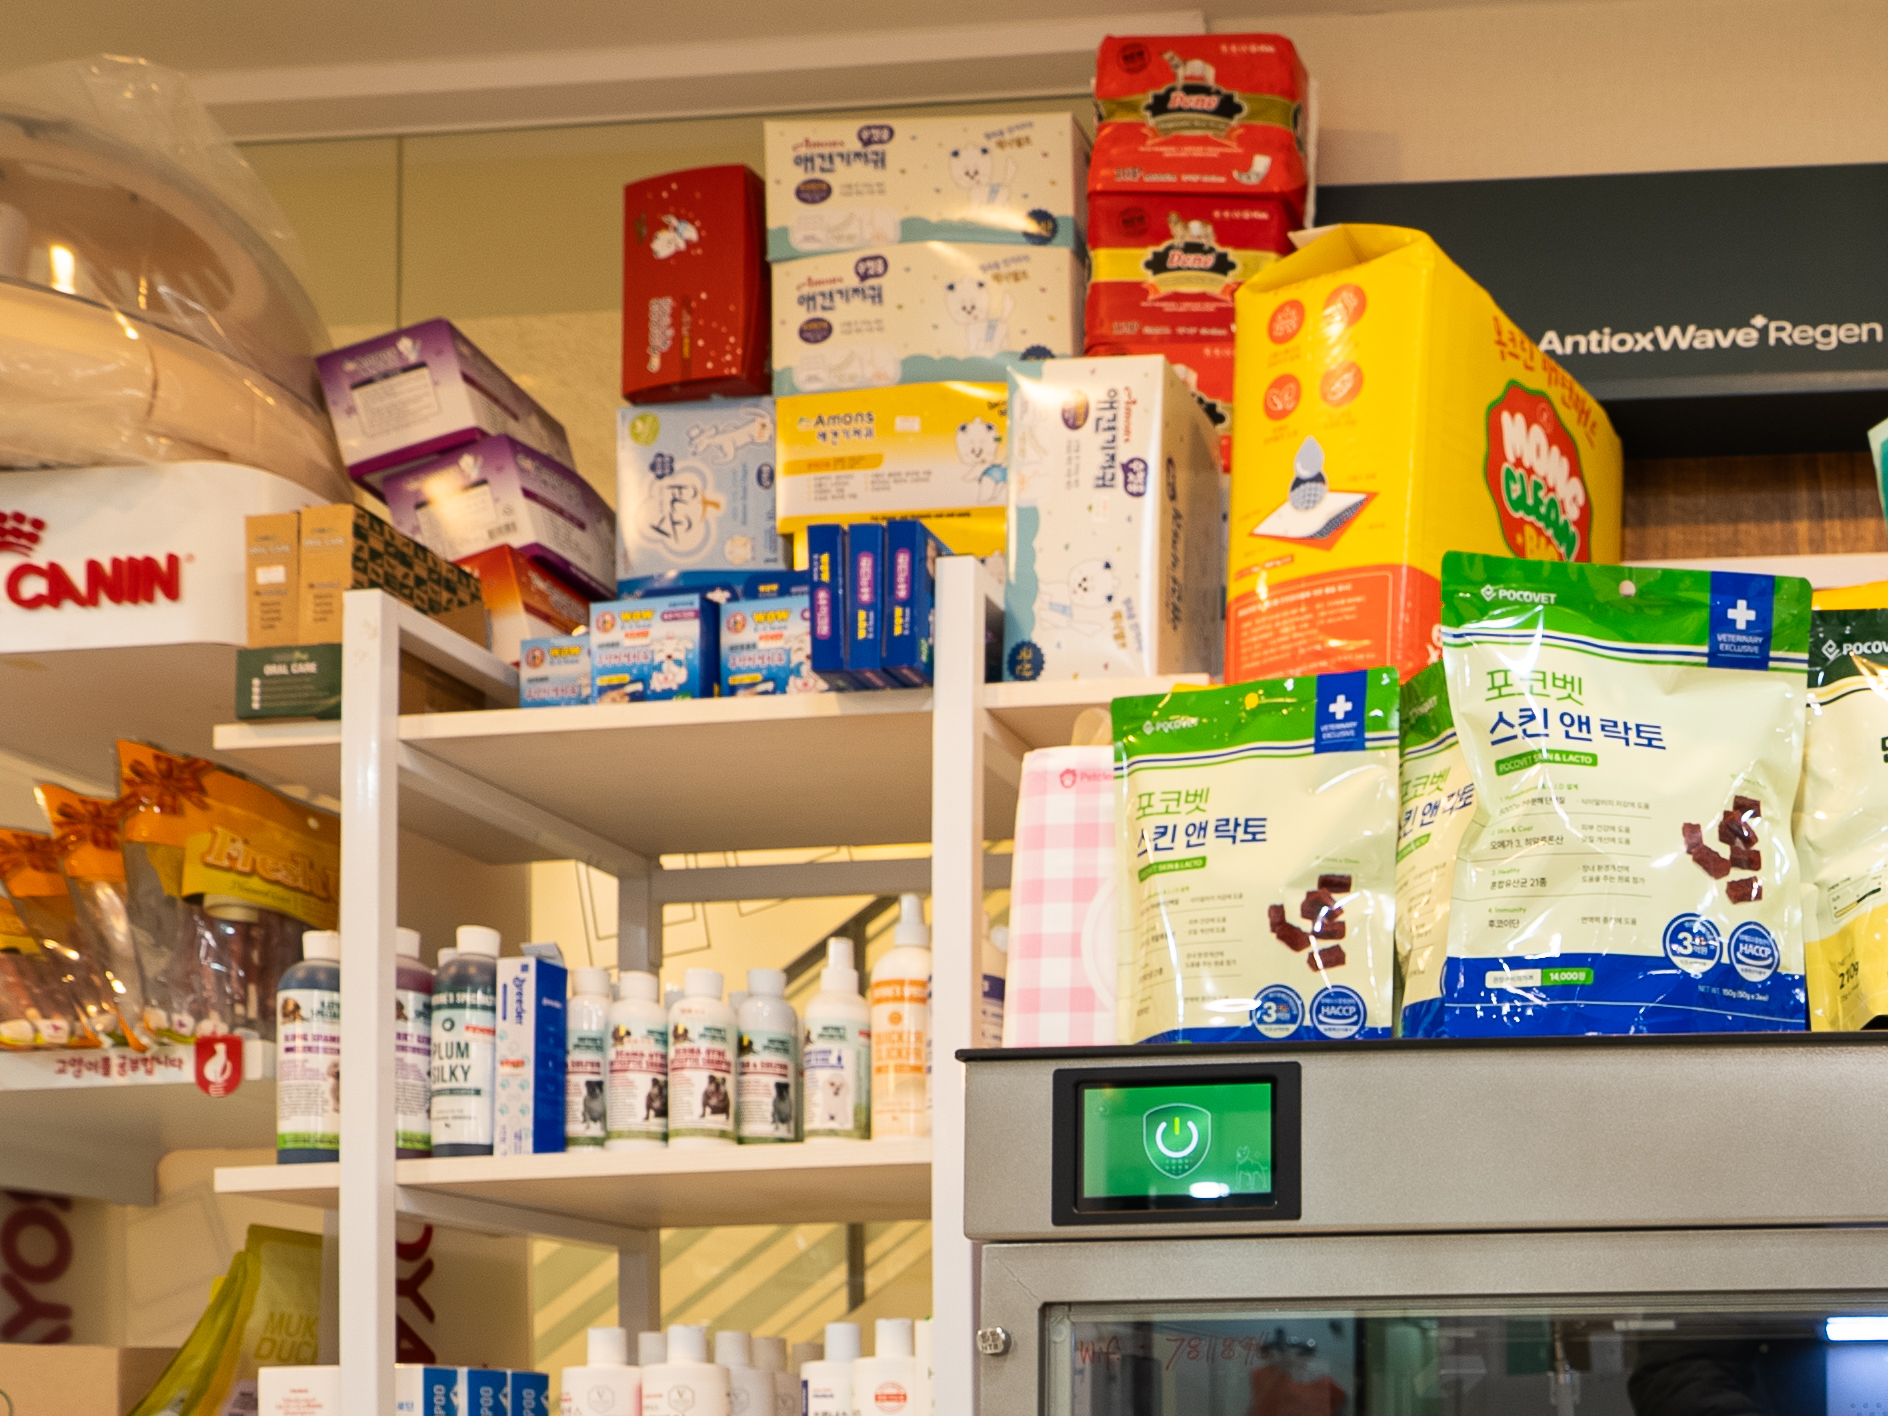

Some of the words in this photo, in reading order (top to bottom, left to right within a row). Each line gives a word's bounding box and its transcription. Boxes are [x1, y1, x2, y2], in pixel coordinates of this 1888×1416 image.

[1539, 321, 1757, 355] AntioxWave
[1769, 319, 1883, 351] Regen
[814, 411, 875, 427] Amons
[6, 554, 180, 610] CANIN
[1499, 588, 1557, 605] POCOVET
[1717, 633, 1763, 645] VETERINARY
[1719, 643, 1760, 654] EXCLUSIVE
[1485, 669, 1584, 706] 포코벳
[1489, 707, 1550, 746] 스킨
[1559, 712, 1593, 742] 앤
[1600, 718, 1666, 750] 락토
[1136, 787, 1210, 820] 포코벳
[1137, 823, 1177, 857] 스킨
[1185, 820, 1208, 848] 앤
[1214, 817, 1267, 845] 락토
[1739, 944, 1771, 958] HACCP
[1321, 1004, 1356, 1017] HACCP
[432, 1065, 471, 1084] SILKY
